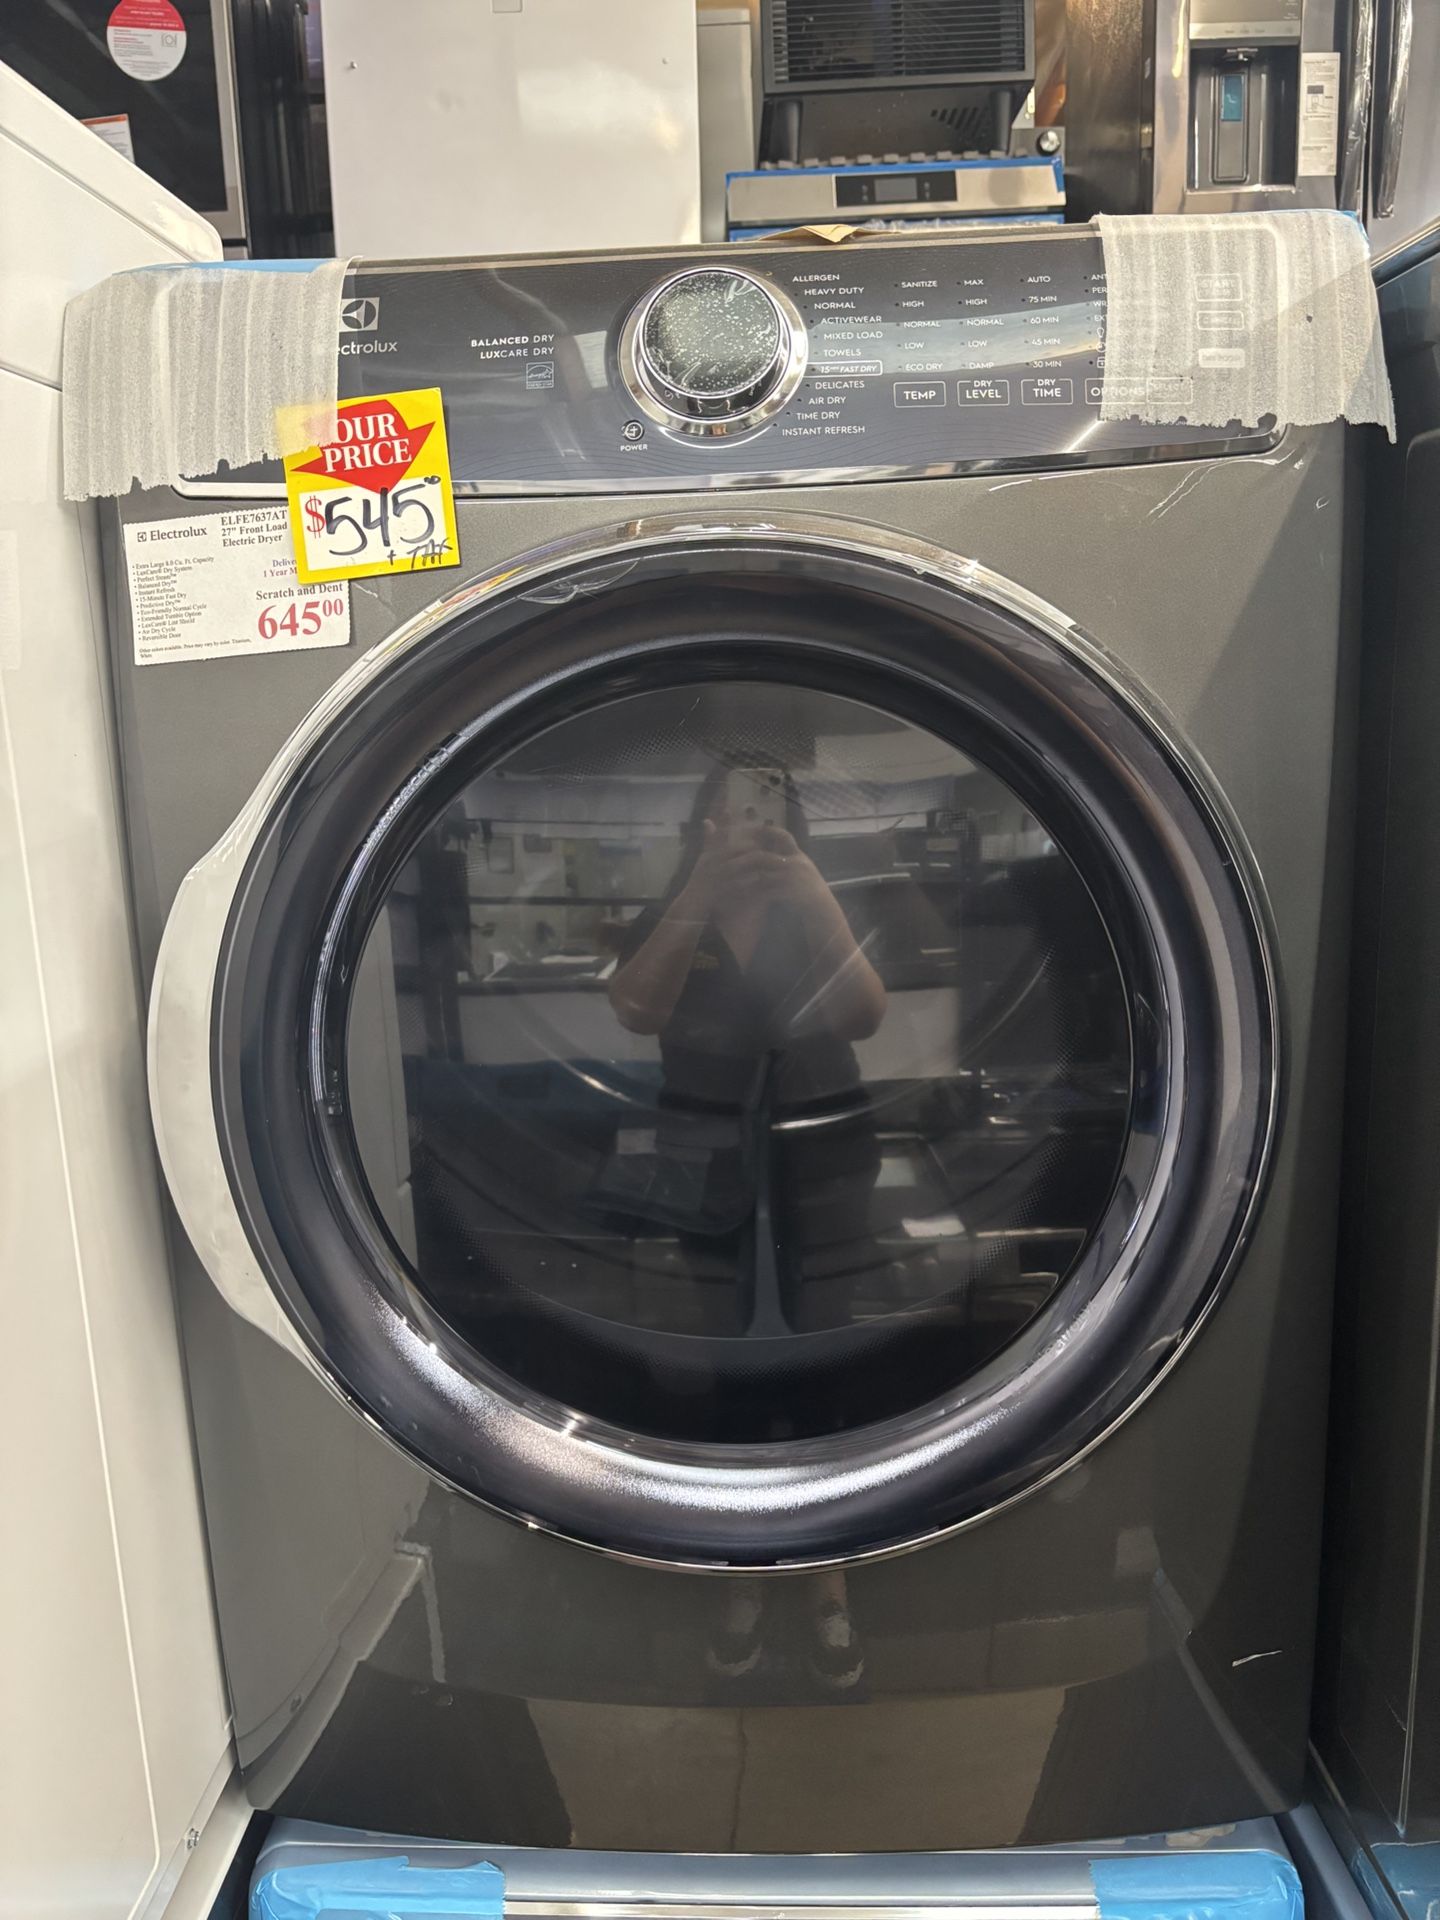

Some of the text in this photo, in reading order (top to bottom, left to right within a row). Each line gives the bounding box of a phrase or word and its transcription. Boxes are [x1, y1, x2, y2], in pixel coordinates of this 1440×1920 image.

[792, 274, 840, 282] ALLERGEN
[901, 280, 938, 288] SANITIZE
[804, 288, 836, 296] HEAVY
[814, 302, 856, 310] NORMAL
[820, 316, 882, 325] ACTIVEWEAR
[824, 331, 883, 340] MIXED LOAD
[471, 334, 554, 348] BALANCED DRY
[338, 340, 398, 356] ctrolux
[480, 347, 554, 359] LUXCARE DRY
[823, 349, 861, 357] TOWELS
[815, 380, 865, 390] DELICATES
[904, 390, 936, 400] TEMP
[966, 389, 1002, 399] LEVEL
[1033, 388, 1061, 398] TIME
[808, 396, 846, 405] AIR DRY
[796, 411, 840, 420] TIME DRY
[336, 412, 398, 444] OUR
[782, 426, 865, 436] INSTANT REFRESH
[620, 444, 648, 452] POWER
[324, 438, 412, 473] PRICE
[221, 510, 288, 526] ELFE7637AT
[150, 526, 208, 541] Electrolux
[221, 522, 288, 537] 27" Front Load
[223, 534, 283, 547] Electric Dryer
[270, 568, 287, 577] Year
[256, 582, 343, 600] Scratch and Dent
